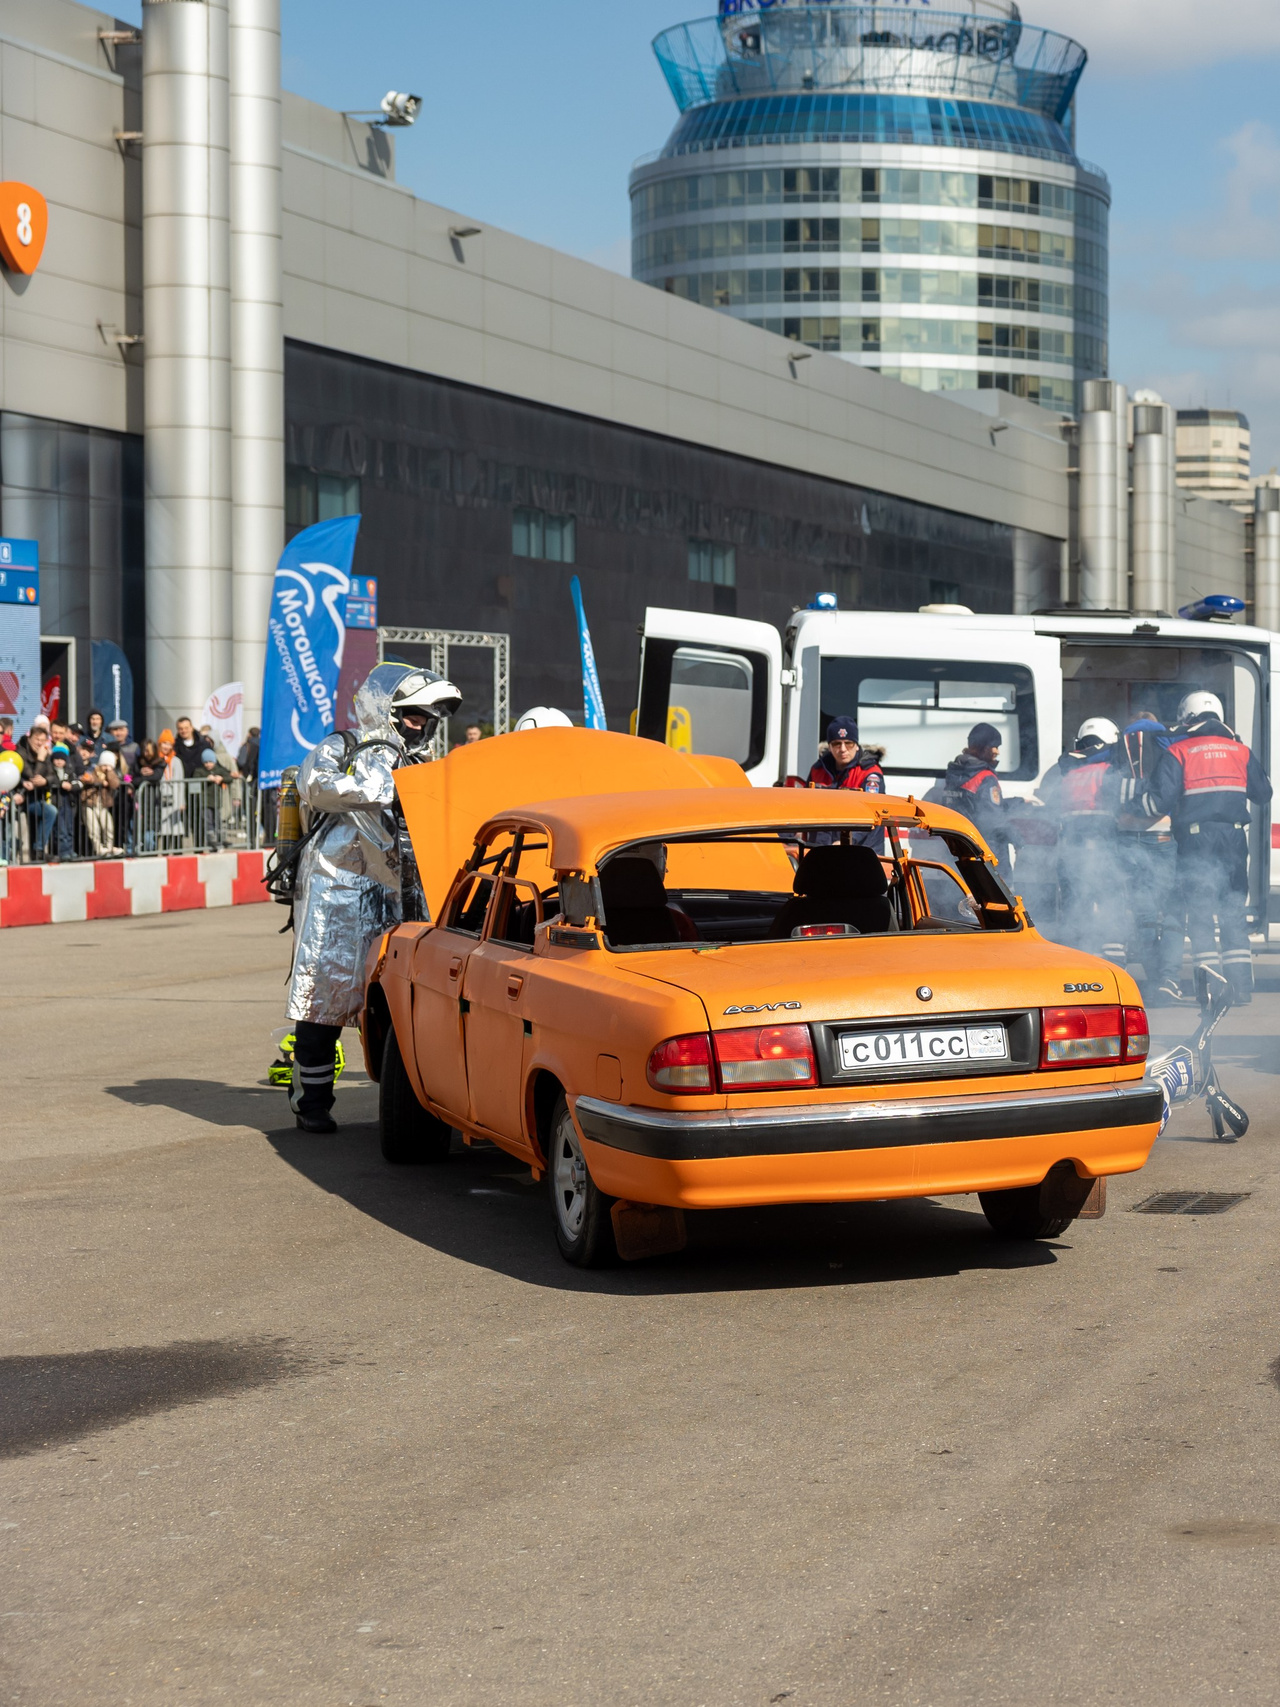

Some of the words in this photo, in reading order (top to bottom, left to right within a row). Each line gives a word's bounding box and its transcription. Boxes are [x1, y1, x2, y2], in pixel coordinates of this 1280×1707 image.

[16, 202, 33, 246] 8
[276, 588, 334, 727] Мотошкола
[1063, 982, 1104, 993] 3110
